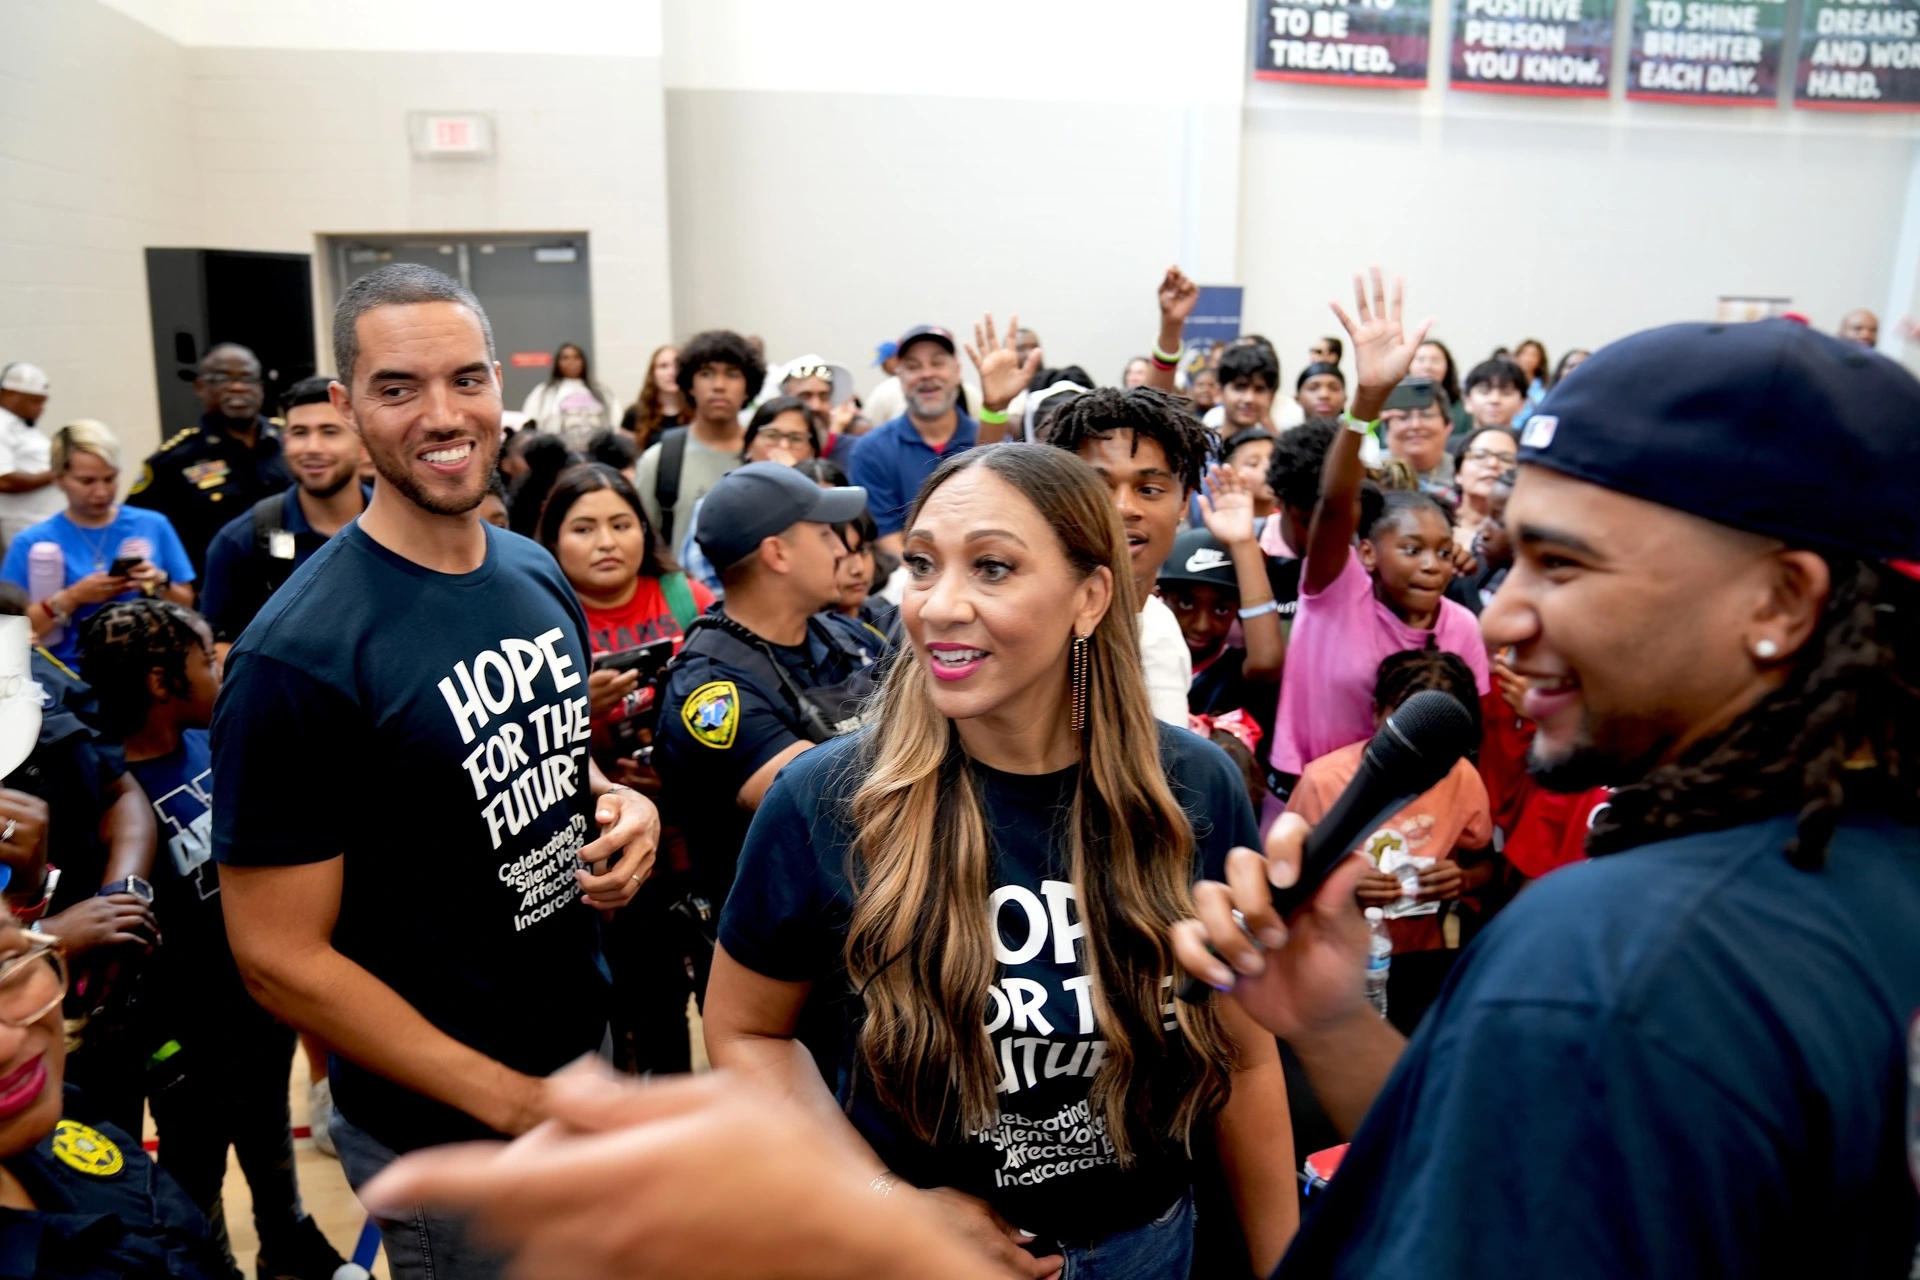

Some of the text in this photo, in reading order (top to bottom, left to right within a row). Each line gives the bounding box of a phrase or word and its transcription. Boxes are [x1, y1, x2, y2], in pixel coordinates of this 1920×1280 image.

[1271, 7, 1349, 38] TO BE
[1647, 1, 1760, 32] TO SHINE
[1817, 7, 1918, 37] DREAMS
[1464, 19, 1566, 51] PERSON
[1643, 31, 1763, 63] BRIGHTER
[1269, 39, 1396, 73] TREATED.
[1463, 50, 1604, 85] YOU KNOW.
[1811, 39, 1920, 69] AND WOR
[1639, 60, 1759, 94] EACH DAY.
[1807, 70, 1881, 99] HARD.
[437, 626, 582, 745] HOPE
[461, 722, 530, 801] FOR
[527, 695, 592, 755] THE
[498, 824, 575, 882] Celebrating
[520, 858, 580, 912] Affected
[513, 880, 582, 932] Incarcera
[986, 879, 1087, 965] OP
[983, 977, 1055, 1036] OR
[1002, 1141, 1098, 1170] Affected
